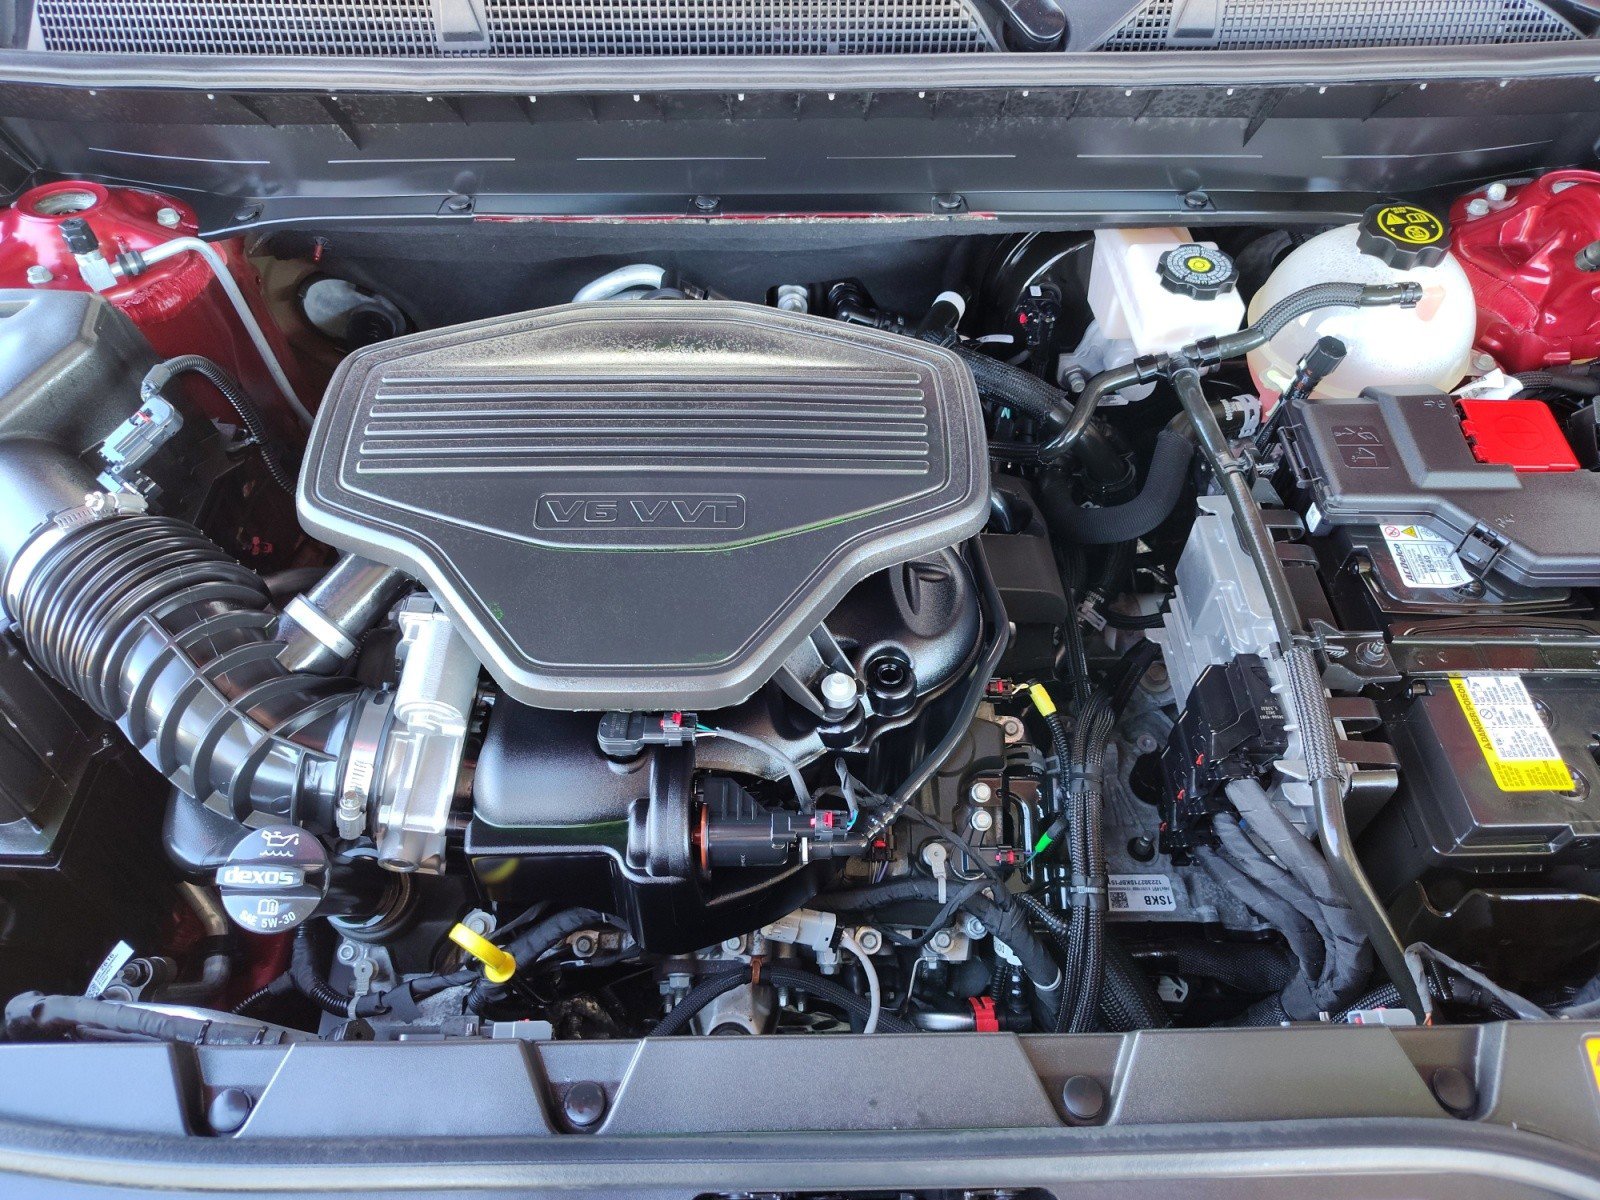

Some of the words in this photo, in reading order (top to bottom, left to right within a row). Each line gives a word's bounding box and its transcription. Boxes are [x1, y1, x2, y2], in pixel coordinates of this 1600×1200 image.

[546, 500, 617, 523] V6
[630, 500, 738, 523] VVT
[1394, 543, 1414, 582] ACDelco
[224, 865, 296, 885] dexos
[1143, 895, 1173, 906] 1SKB
[261, 911, 297, 928] 5W-30
